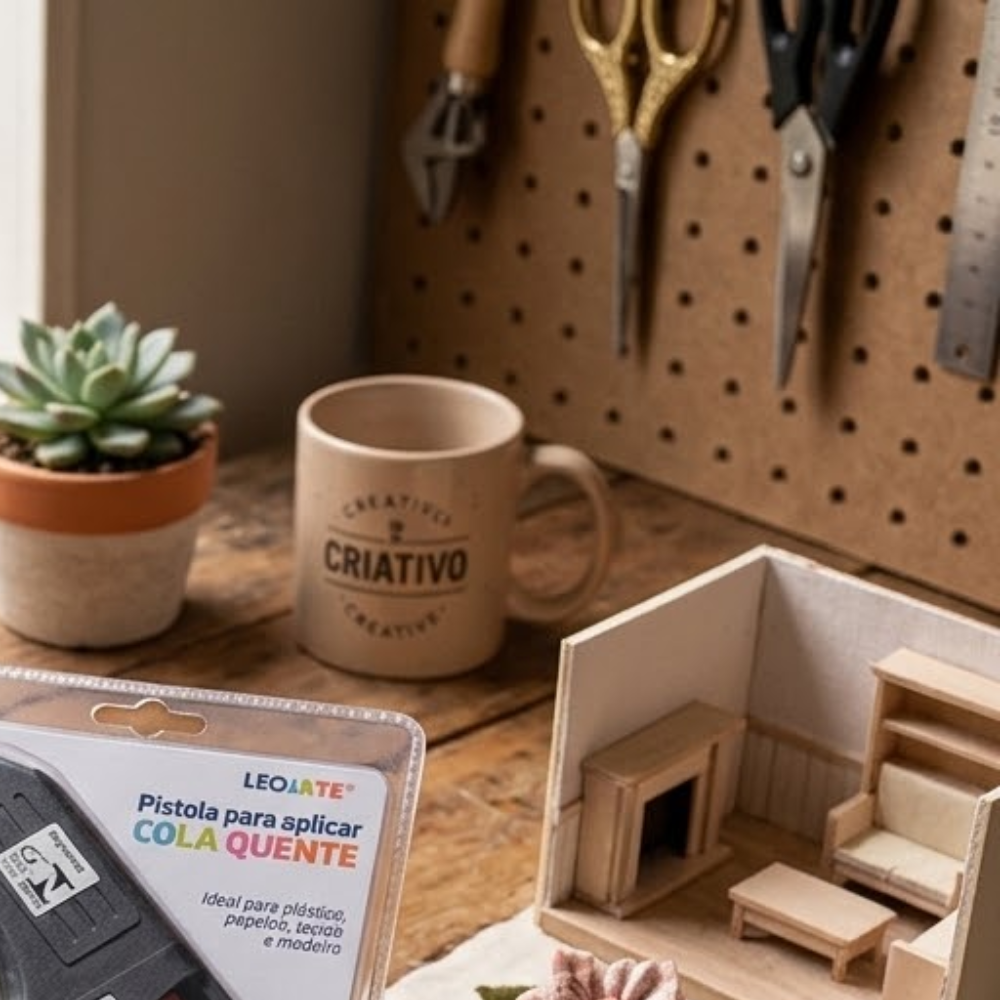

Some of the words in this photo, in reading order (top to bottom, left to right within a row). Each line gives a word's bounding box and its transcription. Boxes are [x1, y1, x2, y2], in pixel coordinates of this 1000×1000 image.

[325, 539, 468, 585] CRIATIVO
[137, 793, 219, 821] Pistola
[223, 808, 277, 829] para
[280, 814, 363, 839] aplicar
[133, 819, 218, 852] COLA
[225, 830, 359, 869] QUENTE
[201, 892, 242, 909] Ideal
[242, 899, 280, 914] para
[263, 936, 274, 948] e
